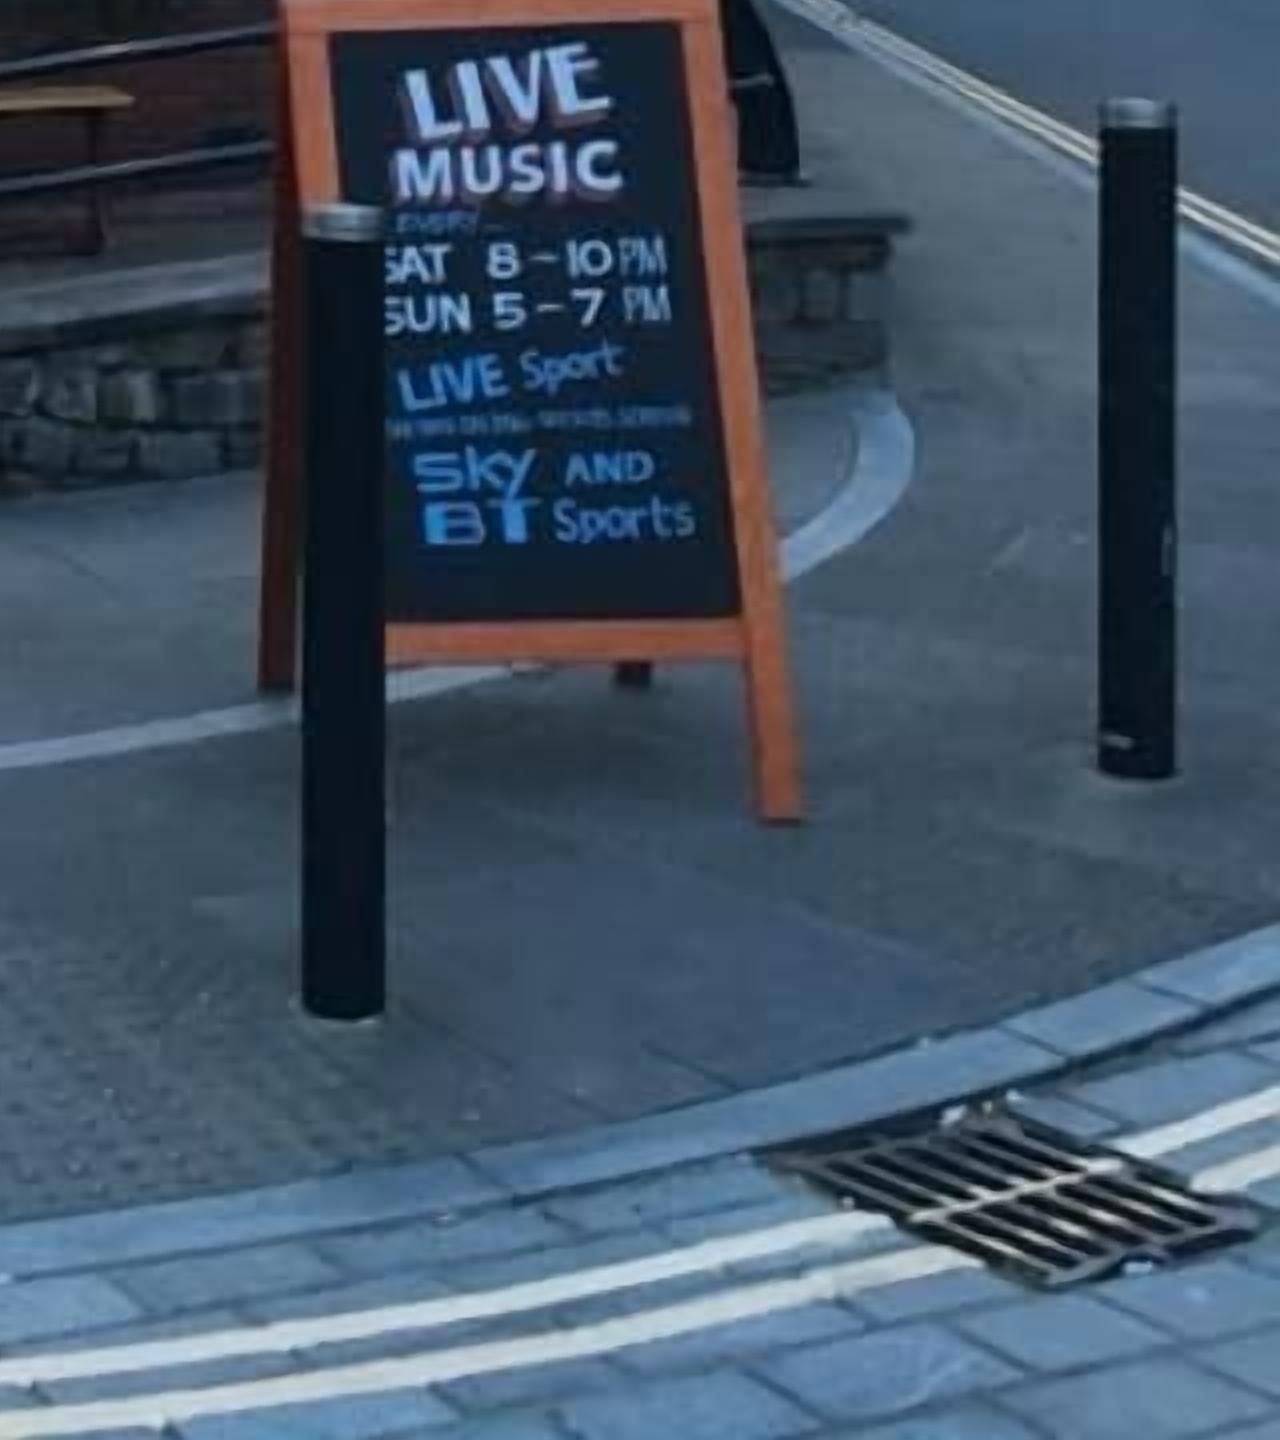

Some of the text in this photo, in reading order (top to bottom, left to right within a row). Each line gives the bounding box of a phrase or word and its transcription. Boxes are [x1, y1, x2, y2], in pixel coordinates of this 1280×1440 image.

[404, 41, 612, 140] LIVE
[394, 140, 624, 200] MUSIC
[384, 243, 452, 285] SAT
[384, 292, 472, 335] SUN
[397, 354, 510, 411] LIVE
[565, 450, 656, 486] AND
[424, 496, 696, 545] BT Sports
